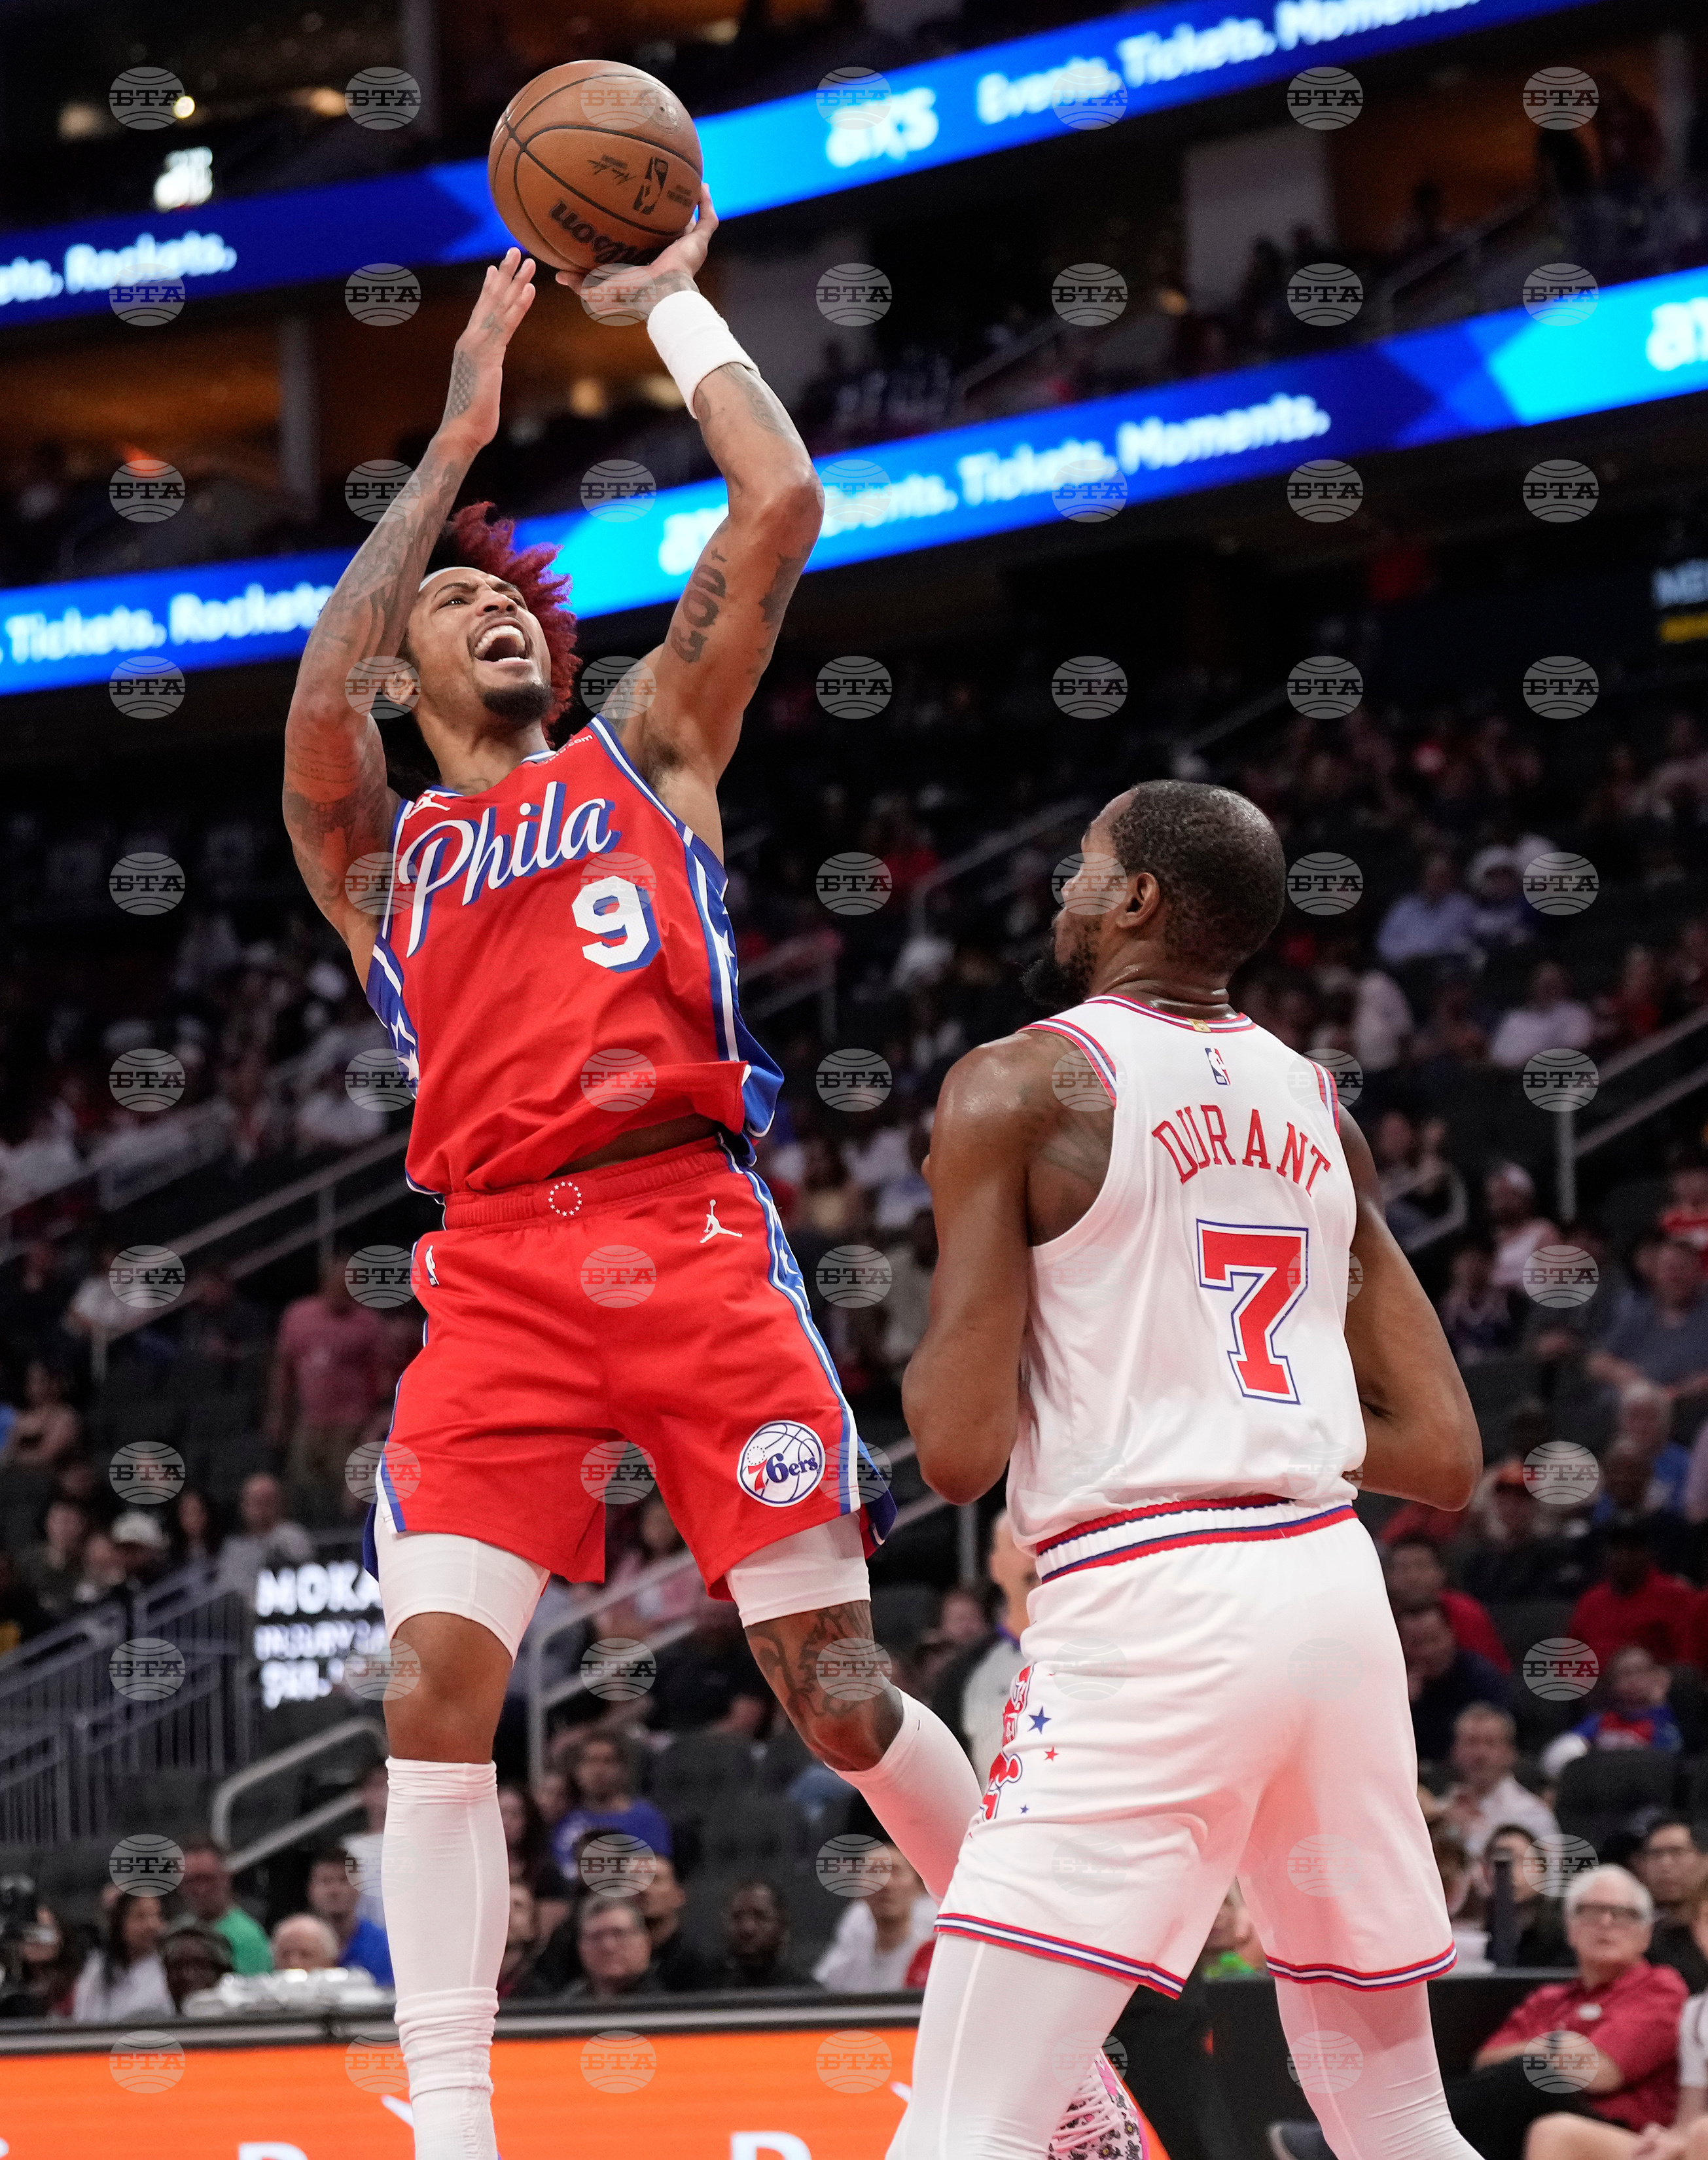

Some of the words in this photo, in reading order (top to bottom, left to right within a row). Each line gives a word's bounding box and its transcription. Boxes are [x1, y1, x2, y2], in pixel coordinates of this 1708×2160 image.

[1118, 18, 1275, 88] Tickets.
[65, 231, 237, 294] Rockets.
[958, 437, 1118, 506] Tickets.
[1116, 393, 1331, 476] Moments.
[6, 607, 166, 664] Tickets.
[398, 780, 621, 958] Phila
[571, 875, 660, 973] 9
[1152, 1104, 1331, 1197] DURANT
[1196, 1218, 1309, 1405] 7
[747, 1452, 818, 1492] 76ers
